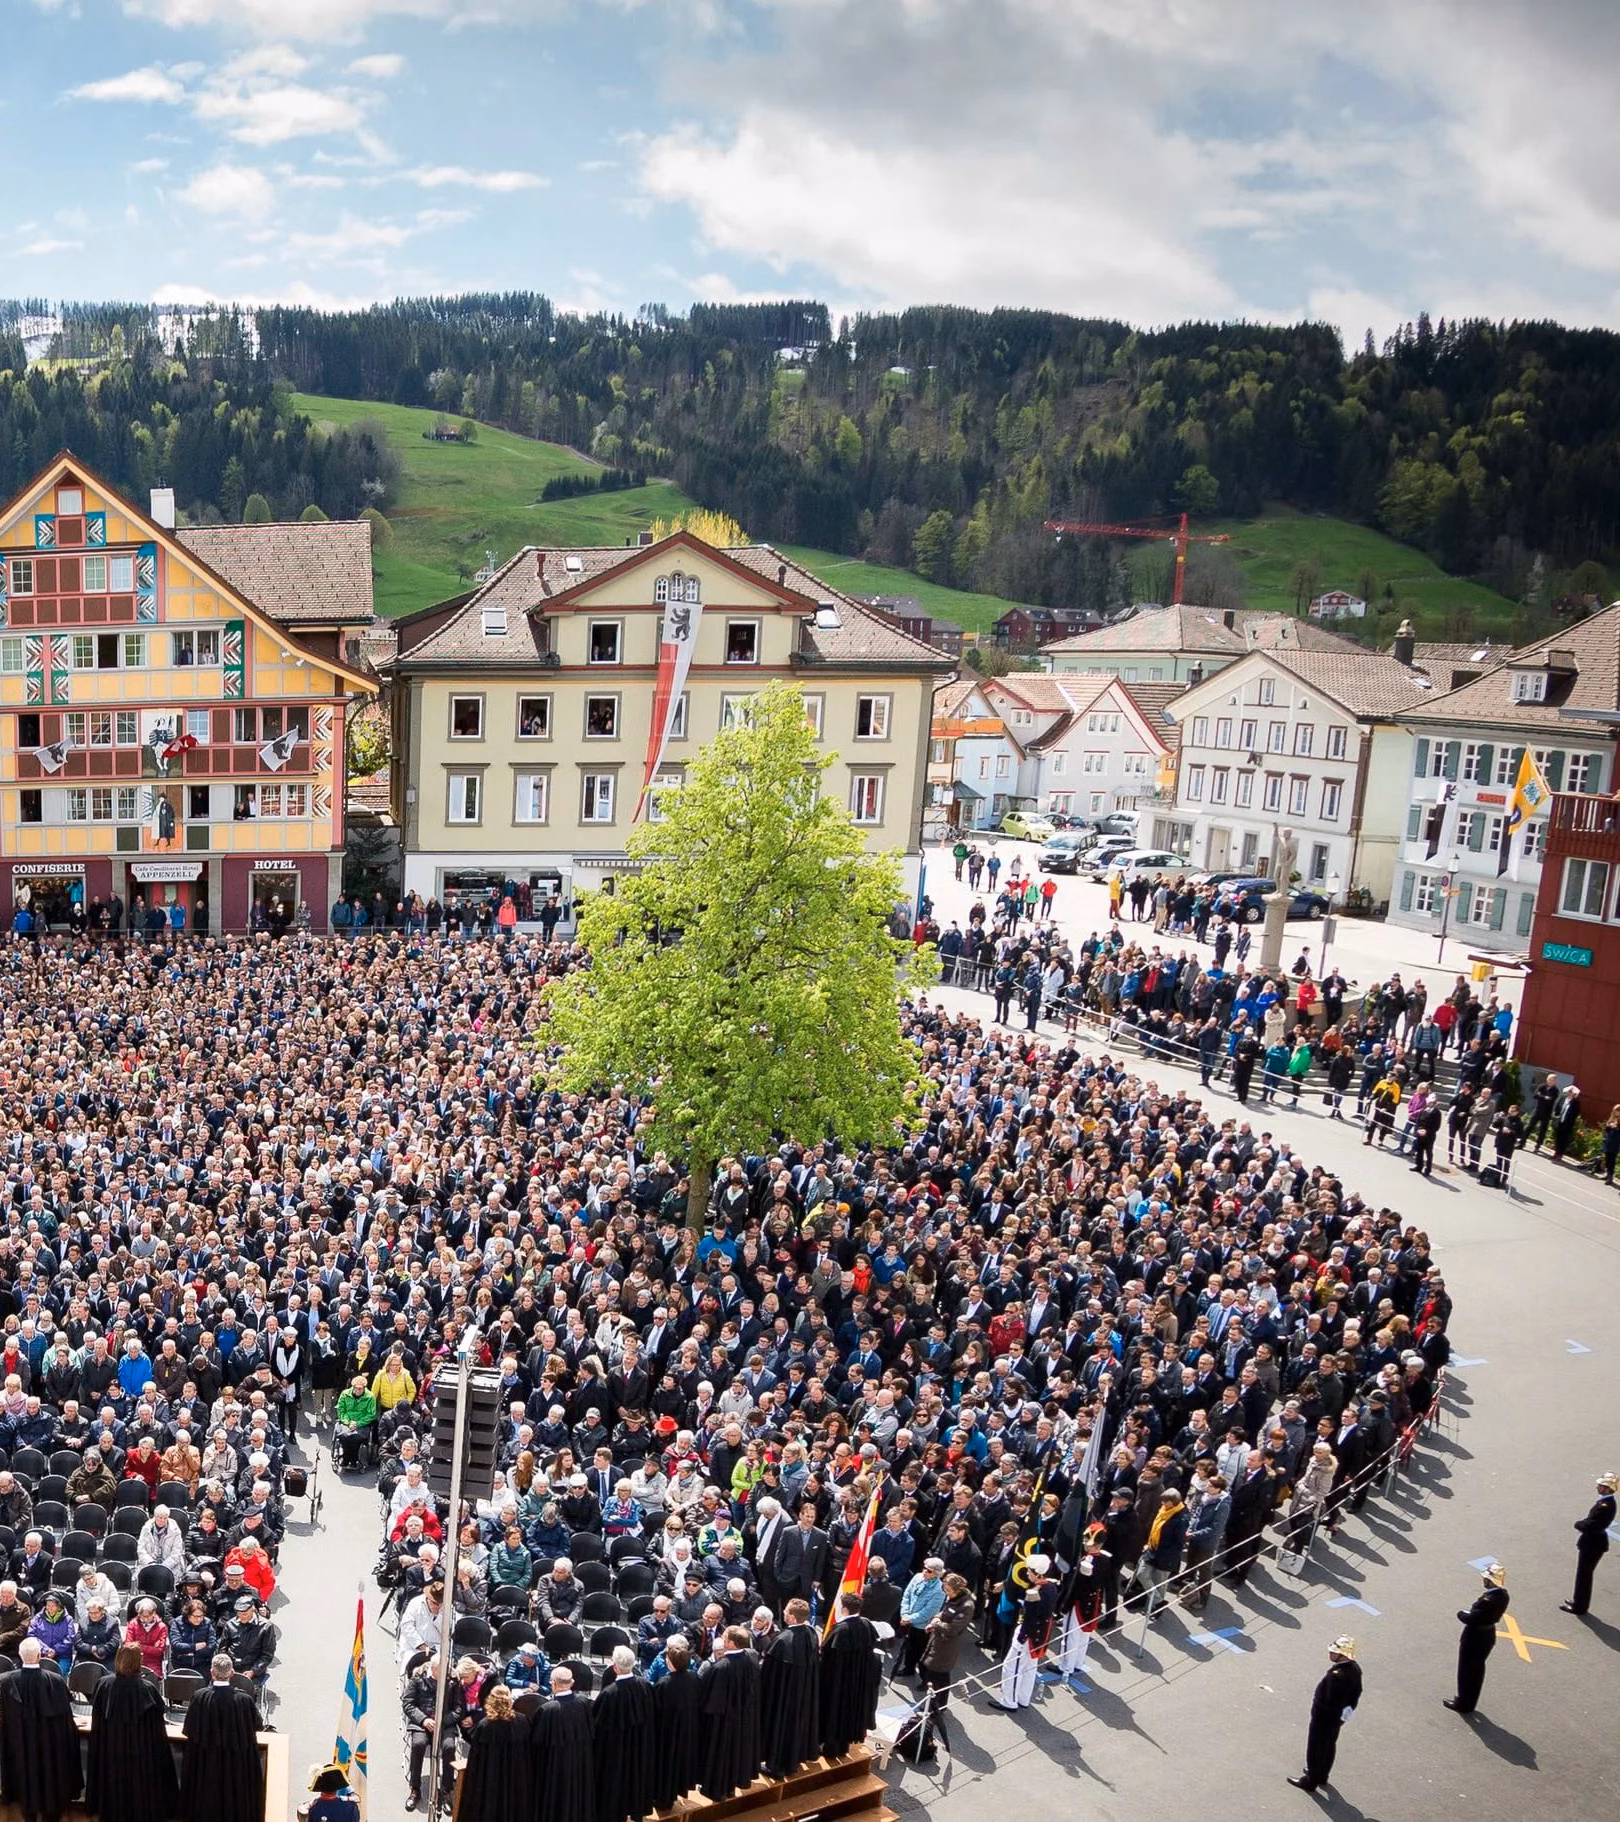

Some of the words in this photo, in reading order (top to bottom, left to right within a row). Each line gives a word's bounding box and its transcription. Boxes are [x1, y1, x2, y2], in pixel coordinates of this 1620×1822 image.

[12, 863, 86, 874] CONFISERIE
[254, 859, 296, 870] HOTEL
[140, 871, 194, 879] APPENZELL
[1545, 945, 1587, 962] SWICA
